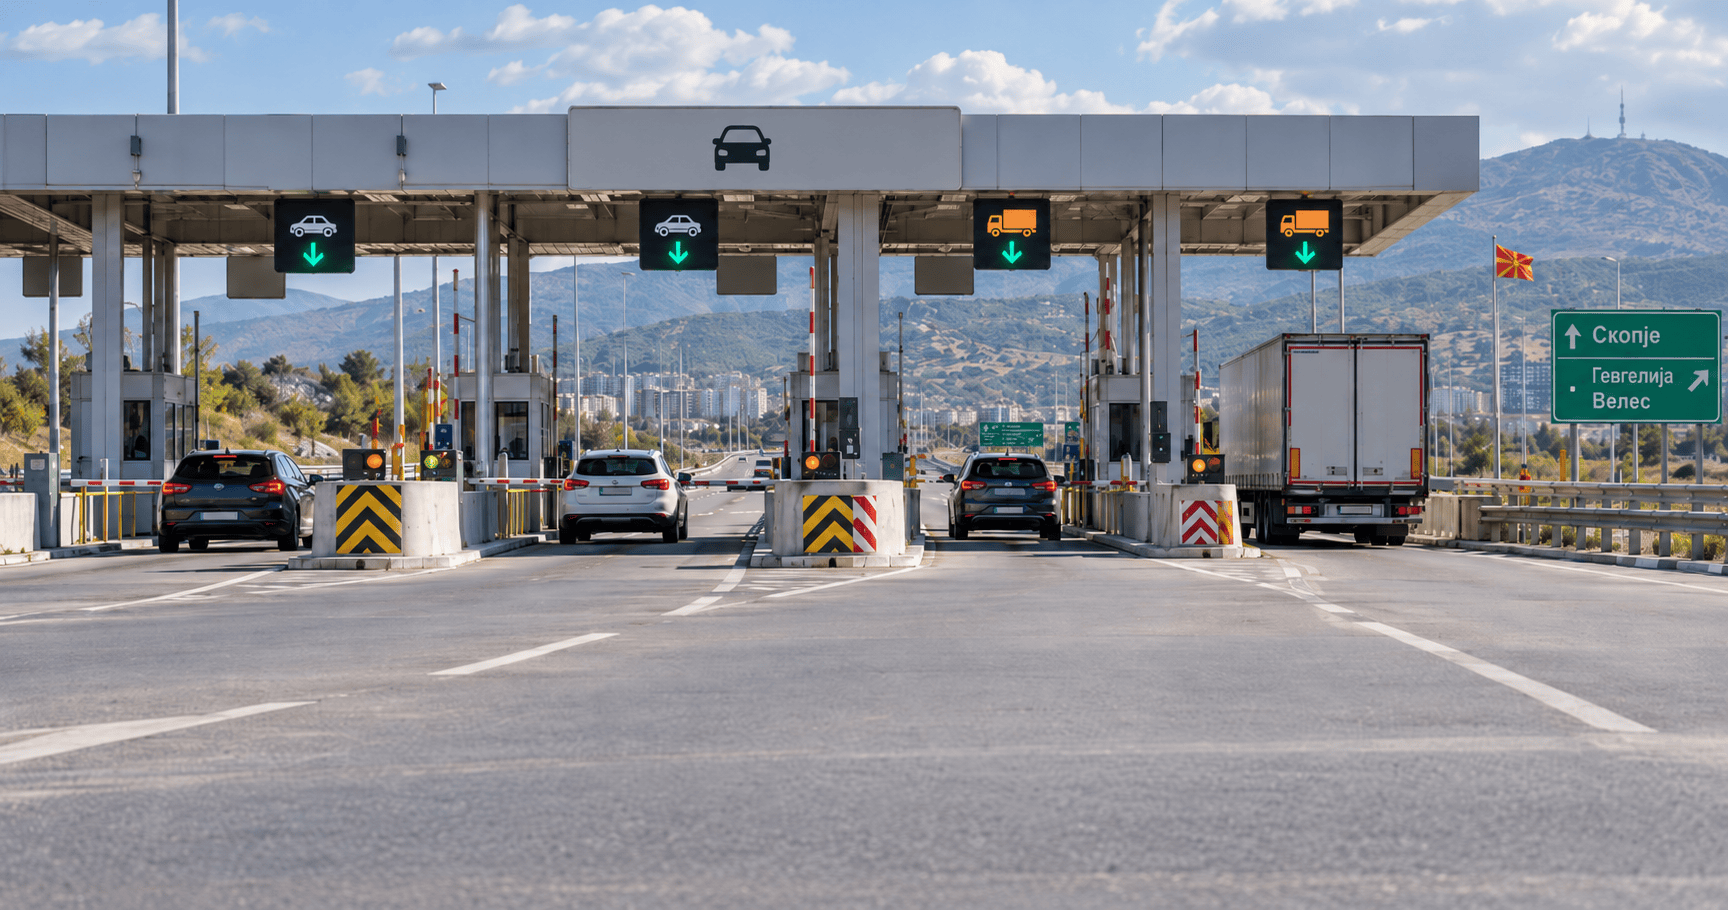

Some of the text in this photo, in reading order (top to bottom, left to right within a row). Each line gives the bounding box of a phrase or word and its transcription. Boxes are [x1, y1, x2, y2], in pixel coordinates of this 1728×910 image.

[1592, 325, 1661, 348] Скопје
[1592, 366, 1674, 388] Гевгелија
[1592, 391, 1651, 410] Велес
